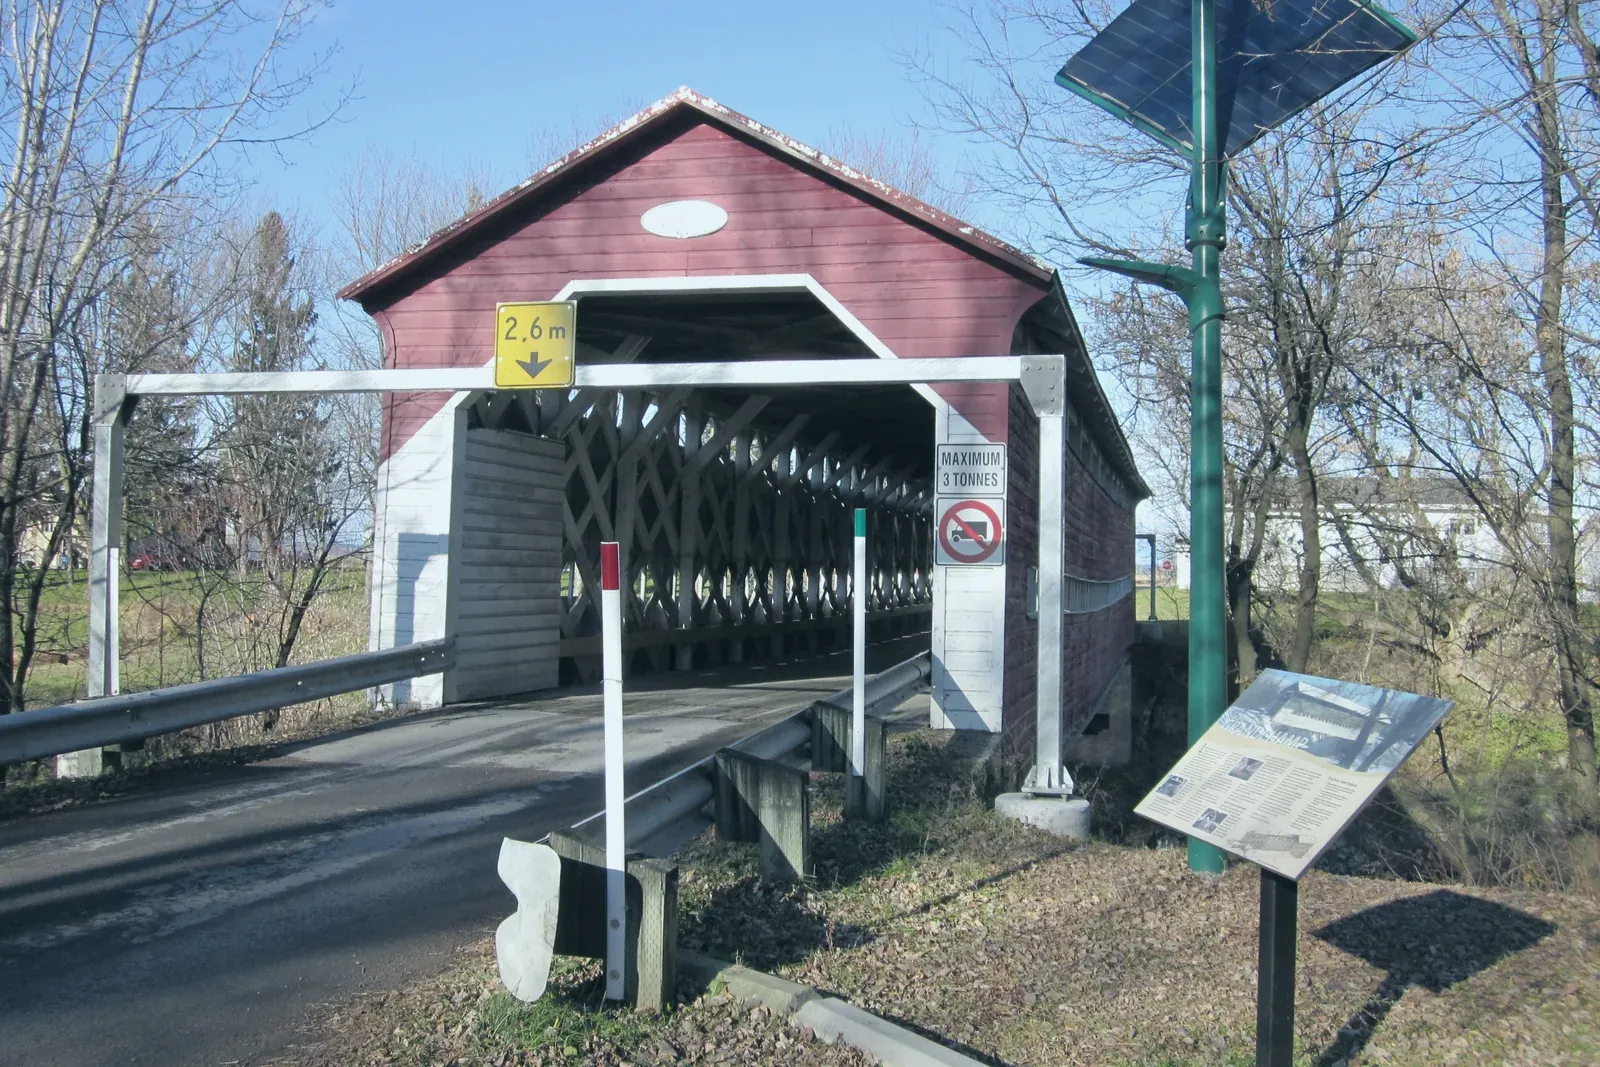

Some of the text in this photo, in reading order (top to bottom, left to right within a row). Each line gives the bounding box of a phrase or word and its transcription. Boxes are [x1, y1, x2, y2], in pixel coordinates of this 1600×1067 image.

[505, 316, 566, 343] 2,6 m
[942, 451, 1000, 466] MAXIMUM
[943, 472, 998, 487] 3 TONNES
